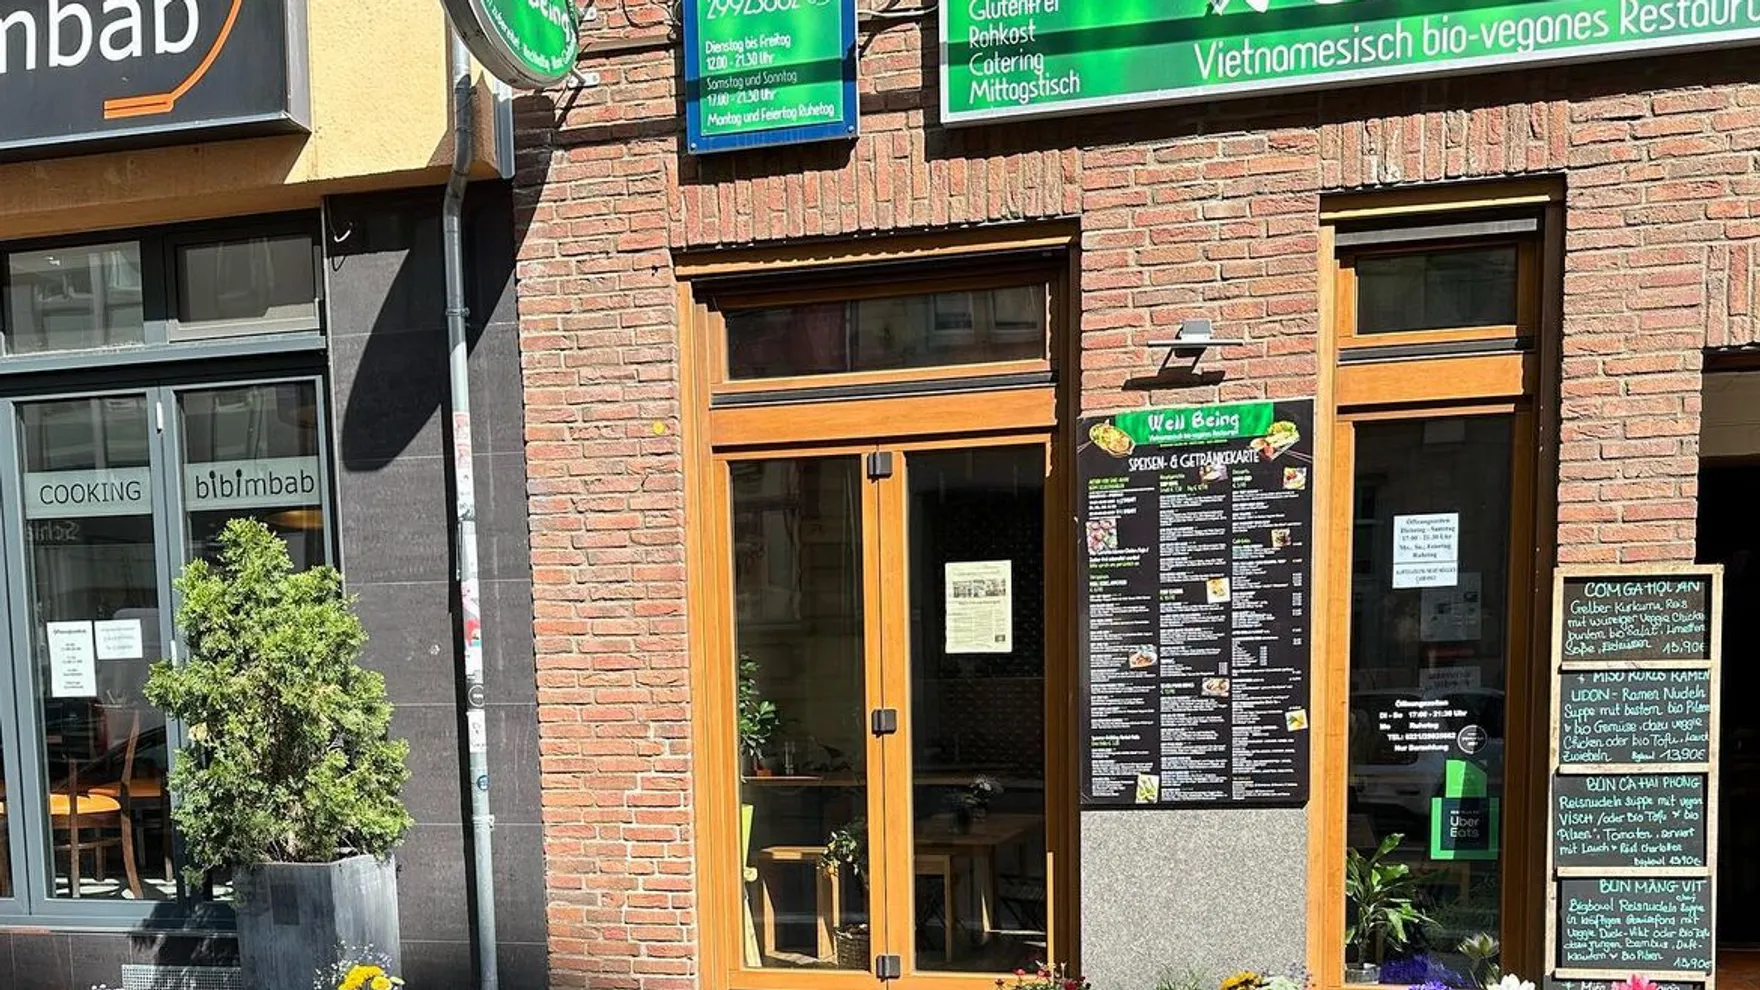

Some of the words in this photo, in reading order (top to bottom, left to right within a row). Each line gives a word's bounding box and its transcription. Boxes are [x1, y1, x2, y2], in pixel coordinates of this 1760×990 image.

[705, 40, 744, 54] Dienstag
[745, 37, 758, 50] bis
[760, 34, 791, 48] Freitag
[968, 22, 1036, 48] Rohkost
[1194, 20, 1413, 80] Vietnamesisch
[1422, 9, 1610, 56] bio-veganes
[735, 53, 758, 67] 21.30
[759, 52, 774, 64] Uhr
[968, 51, 1045, 76] Catering
[706, 77, 744, 91] Samstag
[745, 73, 762, 86] und
[762, 70, 798, 84] Sonntag
[969, 70, 1080, 105] Mittagstisch
[737, 90, 759, 104] 21.30
[761, 88, 775, 101] Uhr
[707, 113, 742, 127] Montag
[743, 110, 760, 121] und
[761, 107, 797, 121] Feiertag
[798, 103, 835, 118] Ruhetag
[1147, 413, 1185, 431] Well
[1191, 409, 1240, 430] Being
[1128, 456, 1168, 473] SPEISEN-
[1169, 454, 1179, 468] &
[1180, 449, 1260, 468] GETRÄNKEKARTE
[40, 480, 142, 505] COOKING
[195, 468, 315, 500] bibimbab
[1400, 527, 1425, 535] Dienstag
[1430, 525, 1456, 533] Samstag
[1570, 600, 1610, 615] Gelber
[1567, 616, 1588, 628] mit
[1571, 688, 1610, 702] UDON
[1622, 688, 1660, 701] Ramen
[1663, 684, 1706, 700] Nudeln
[1564, 703, 1596, 723] Suppe
[1599, 702, 1621, 716] mit
[1667, 701, 1684, 713] bio
[1408, 721, 1440, 730] Ruhetag
[1562, 735, 1605, 750] Chicken
[1606, 735, 1628, 747] oder
[1632, 733, 1650, 746] bio
[1559, 795, 1623, 810] Reisnudeln
[1657, 794, 1675, 807] mit
[1450, 815, 1479, 828] Uber
[1450, 827, 1480, 838] Eats
[1559, 843, 1579, 856] mit
[1581, 842, 1610, 854] Lauch
[1568, 897, 1614, 914] Bigbowl
[1618, 899, 1678, 913] Reisnudeln
